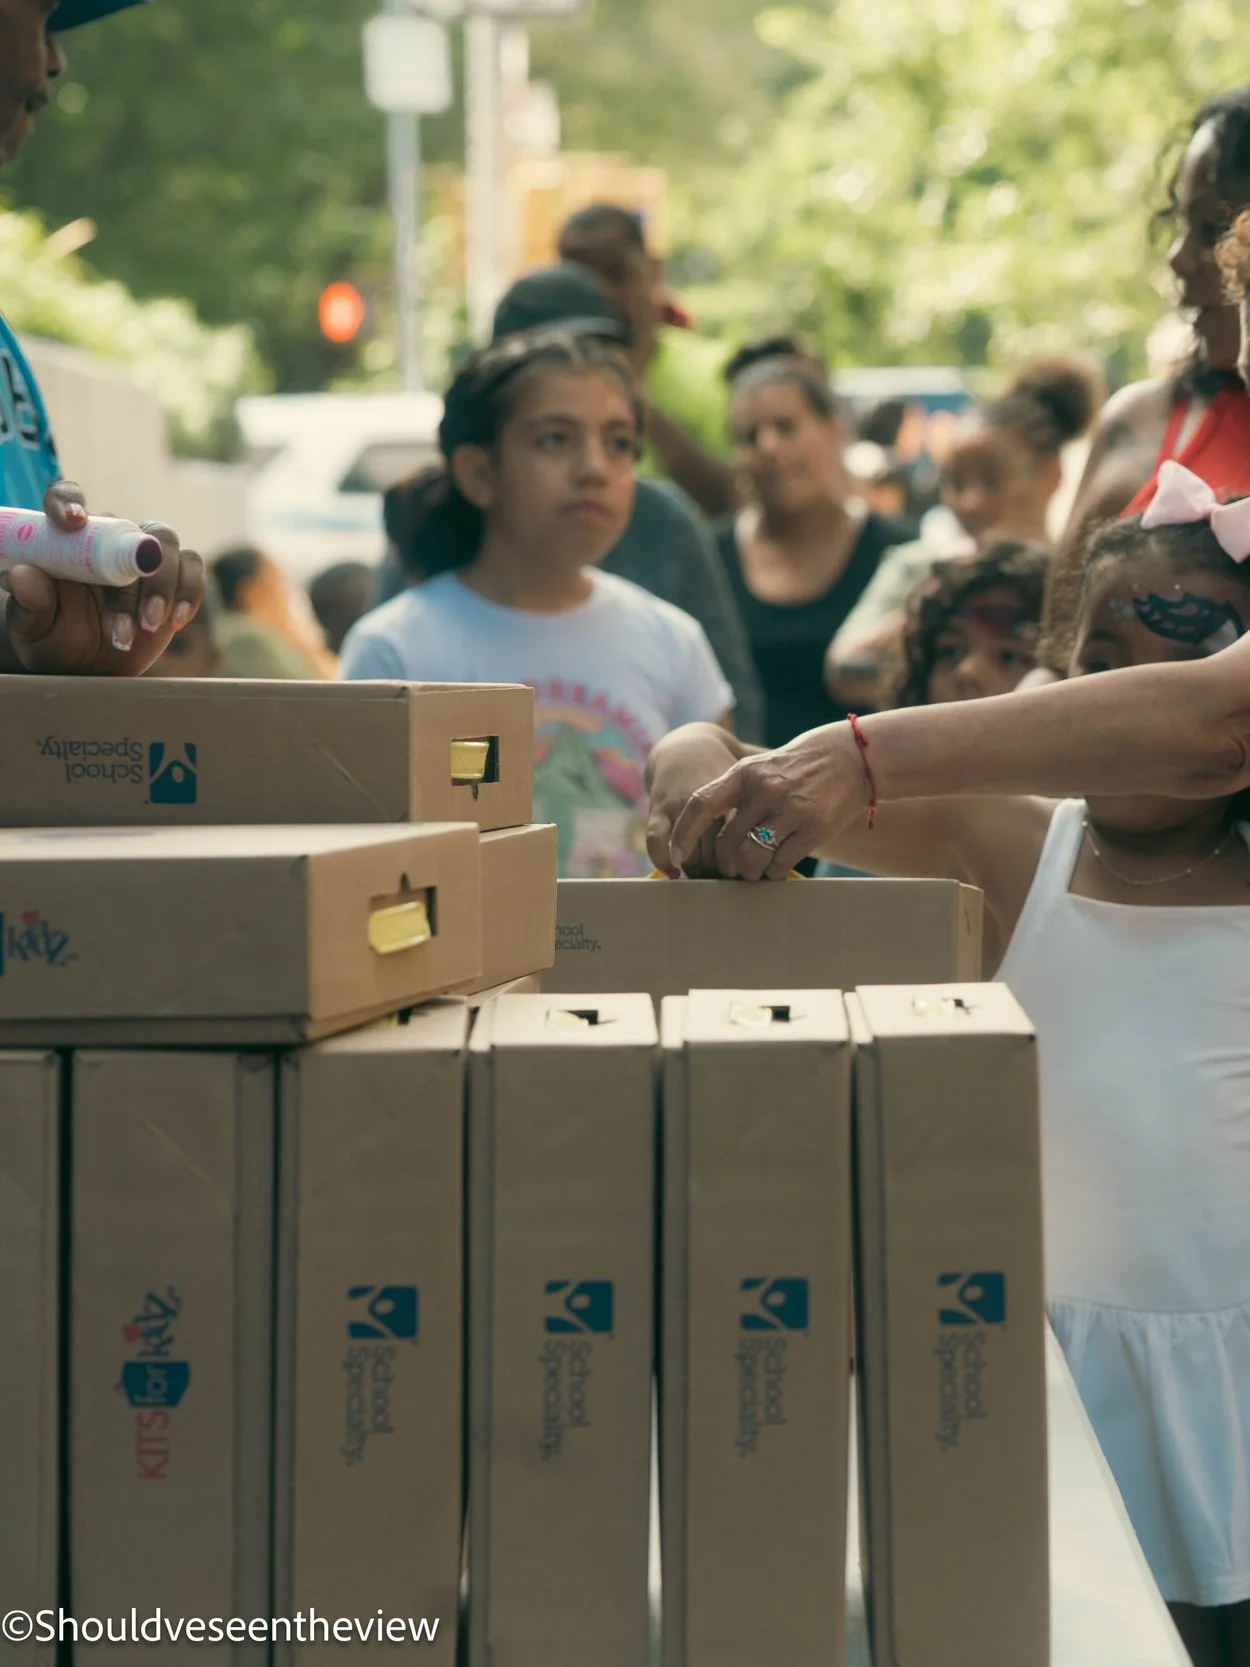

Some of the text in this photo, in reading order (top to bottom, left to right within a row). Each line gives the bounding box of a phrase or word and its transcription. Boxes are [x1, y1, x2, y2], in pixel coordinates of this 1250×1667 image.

[64, 762, 143, 784] School
[370, 1346, 397, 1434] School
[568, 1341, 594, 1428] School
[763, 1338, 788, 1426] School
[963, 1333, 988, 1419] School
[136, 1408, 172, 1480] KITS
